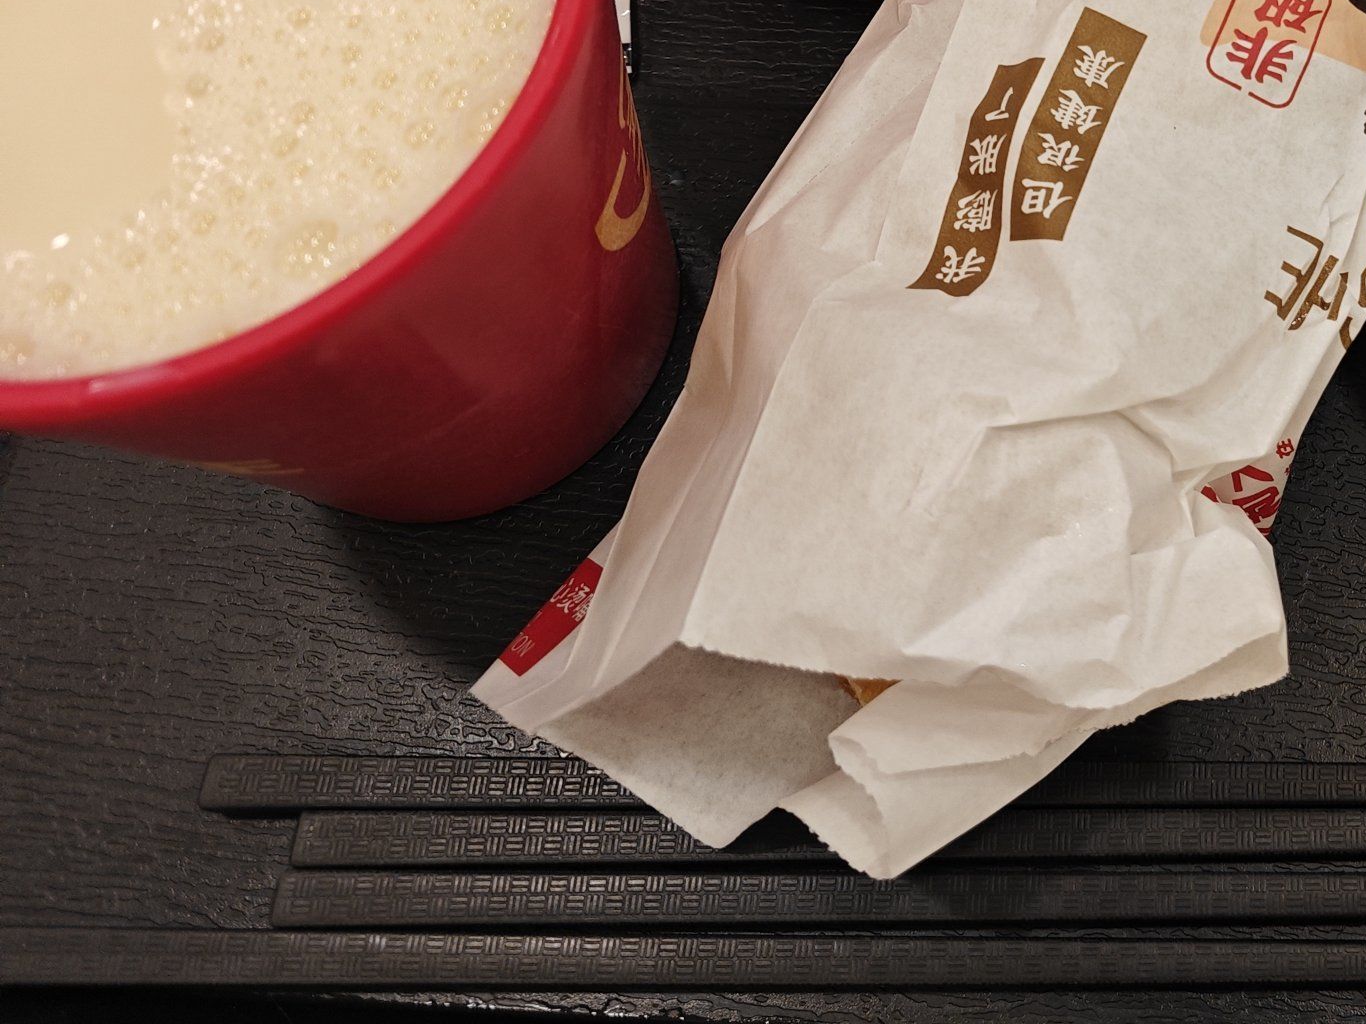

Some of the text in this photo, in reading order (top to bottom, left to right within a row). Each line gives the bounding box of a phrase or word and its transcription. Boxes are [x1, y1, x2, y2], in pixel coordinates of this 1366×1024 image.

[935, 87, 1014, 283] 我膨胀了
[1021, 45, 1126, 218] 但很健康
